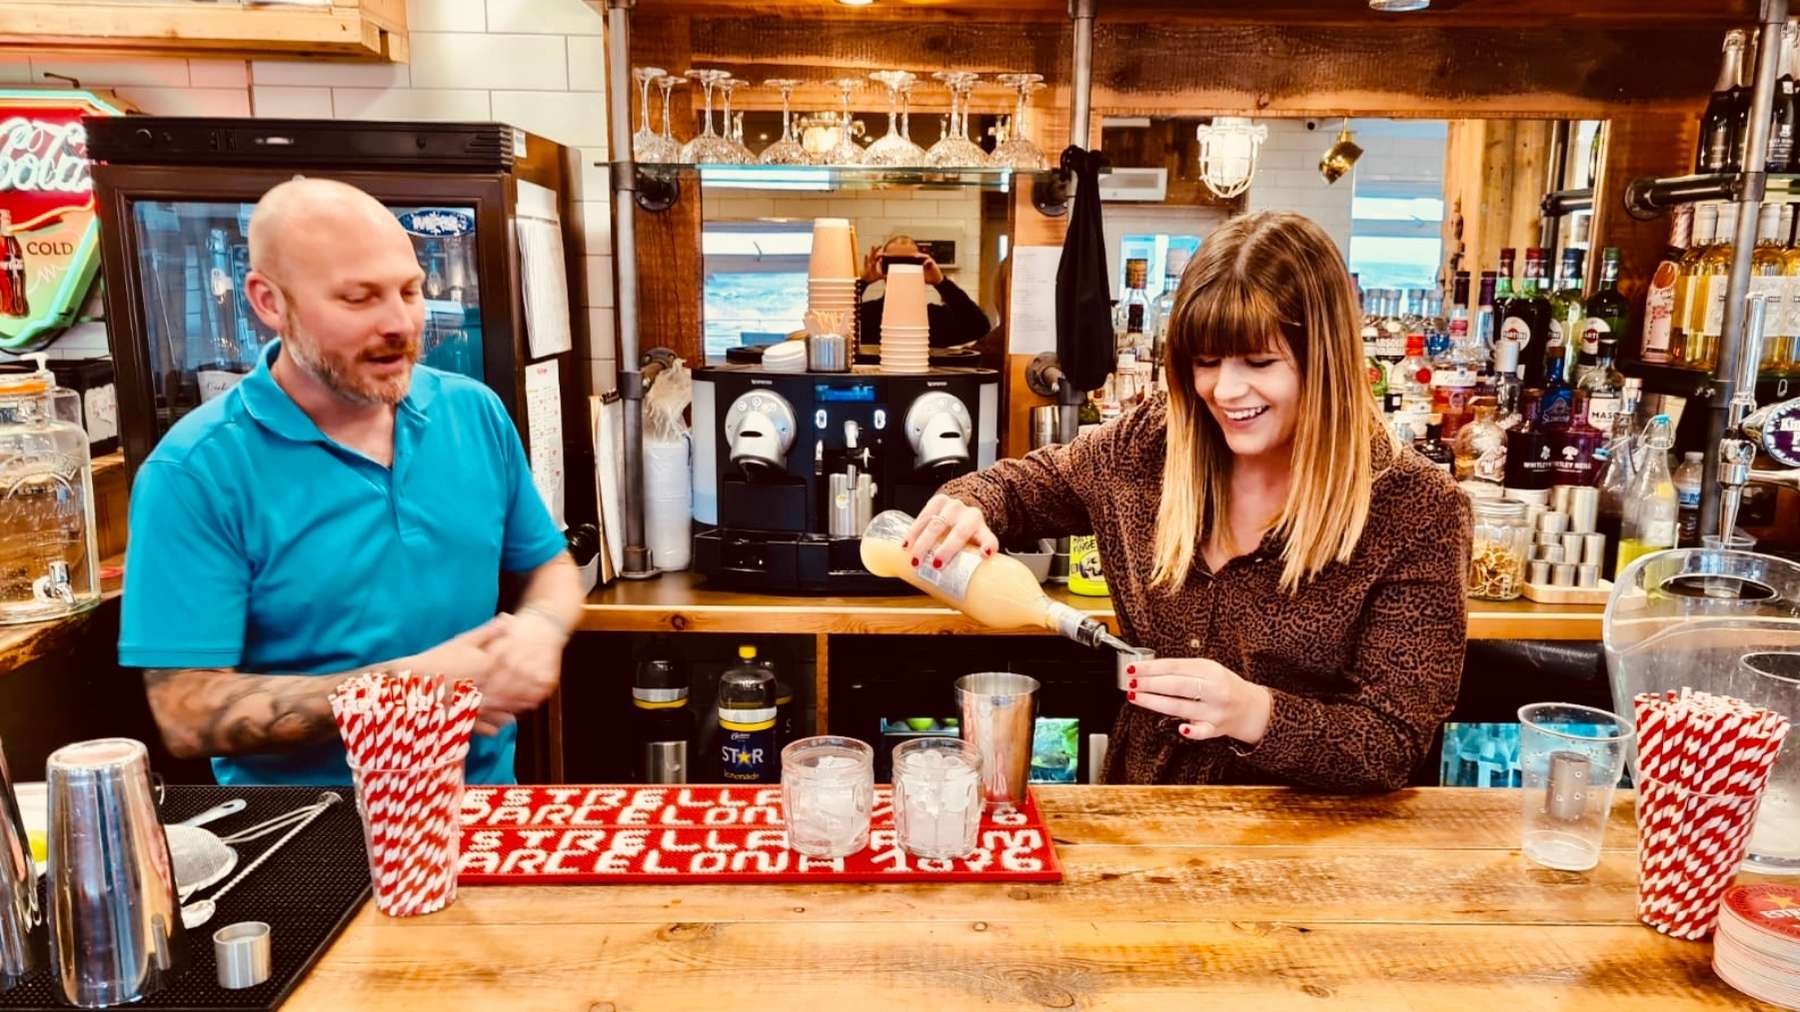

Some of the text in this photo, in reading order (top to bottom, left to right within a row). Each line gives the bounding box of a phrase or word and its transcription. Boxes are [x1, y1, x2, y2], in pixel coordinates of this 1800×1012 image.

[26, 241, 73, 256] COLD
[466, 829, 791, 851] STRELLA
[455, 850, 845, 874] ARCELONA
